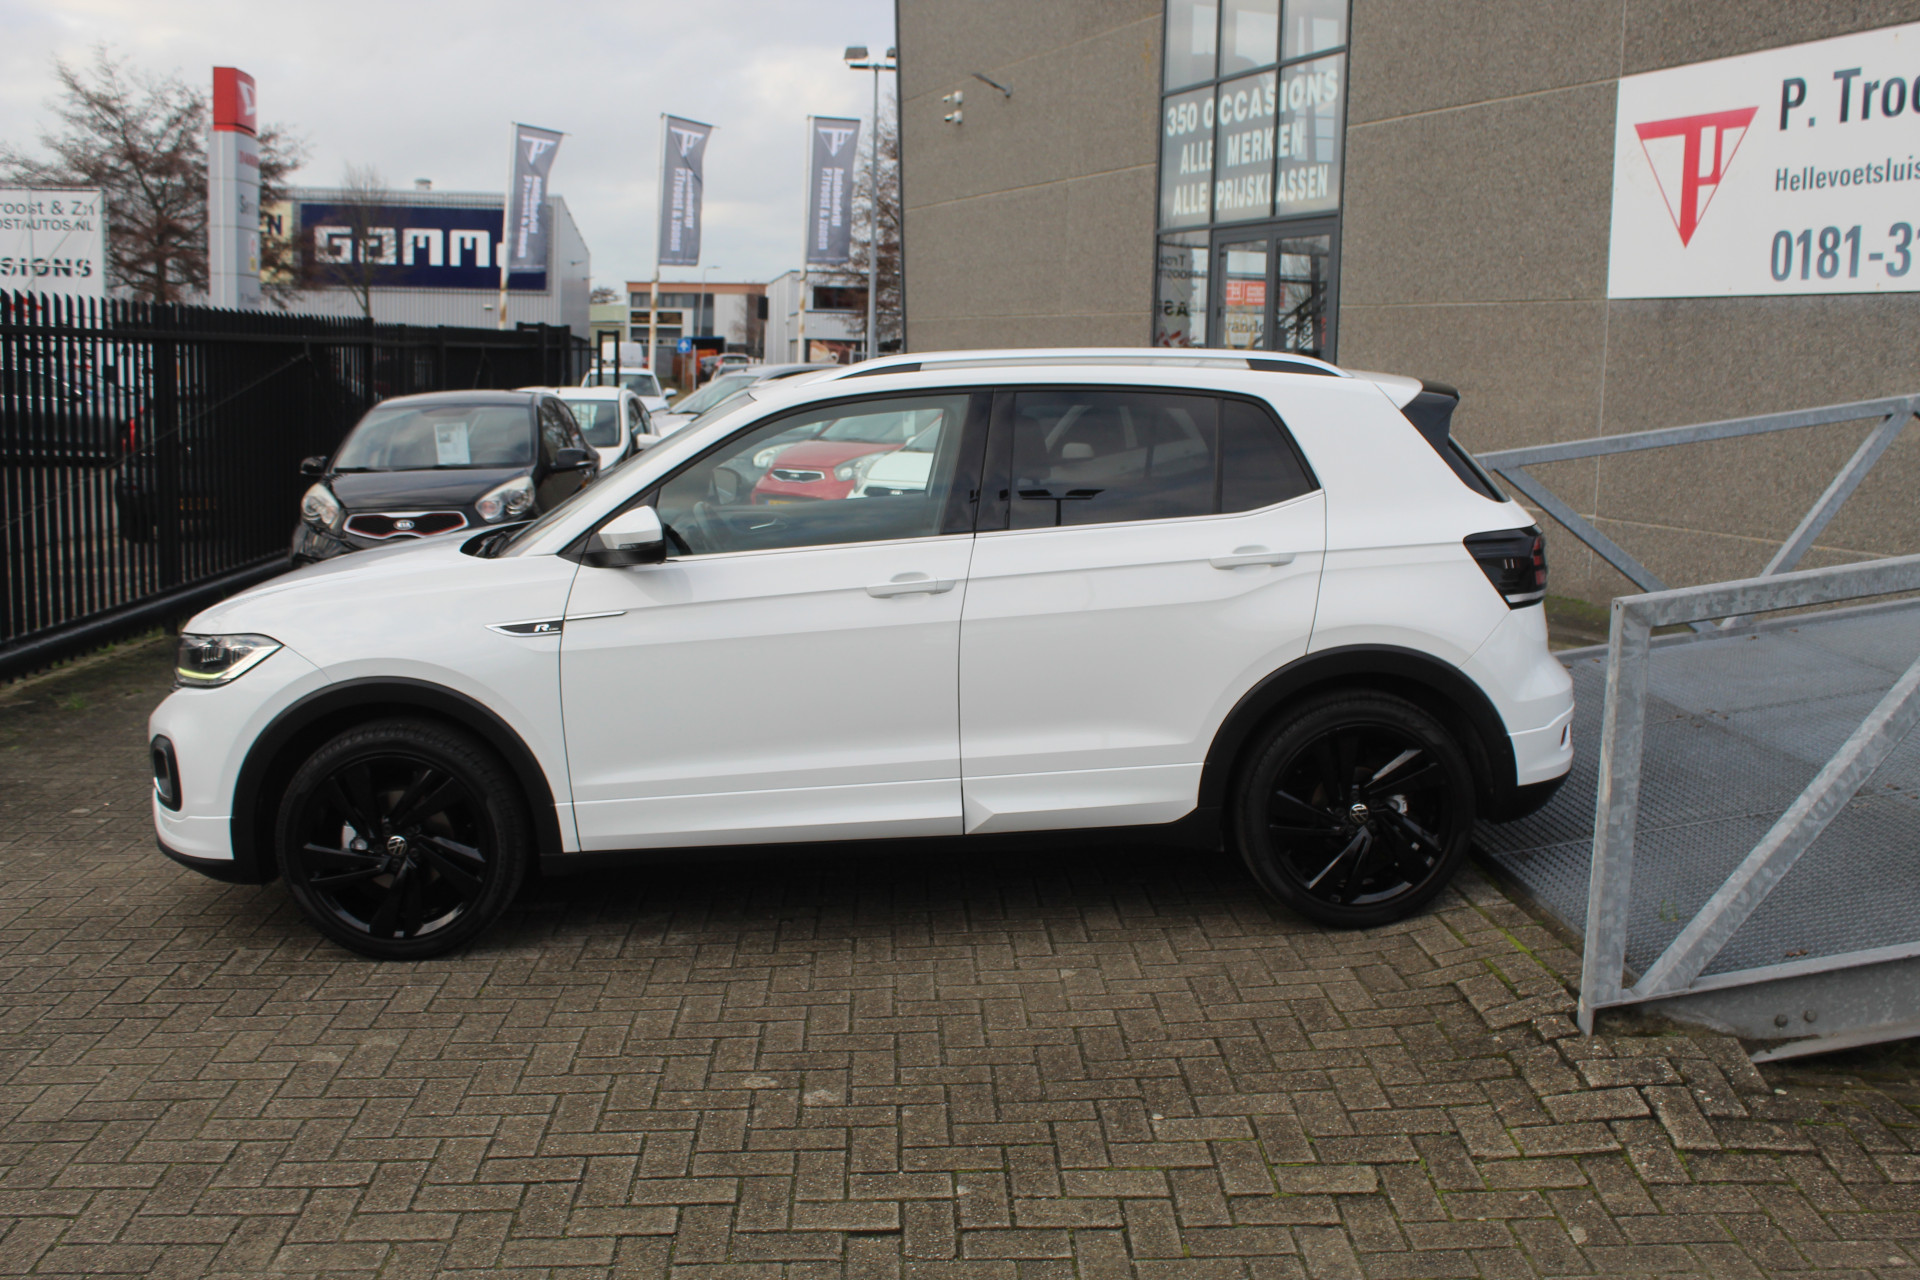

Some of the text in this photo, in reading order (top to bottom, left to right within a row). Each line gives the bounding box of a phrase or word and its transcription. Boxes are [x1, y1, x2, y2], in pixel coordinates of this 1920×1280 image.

[1166, 70, 1338, 137] 350 OCCASIONS
[1779, 77, 1816, 131] P.
[1180, 122, 1304, 175] ALLE MERKEN
[0, 202, 44, 215] oost
[51, 200, 63, 215] &
[0, 218, 94, 231] STAUTOS.NL
[1173, 182, 1207, 216] ALLE
[1771, 221, 1920, 281] 0181-3
